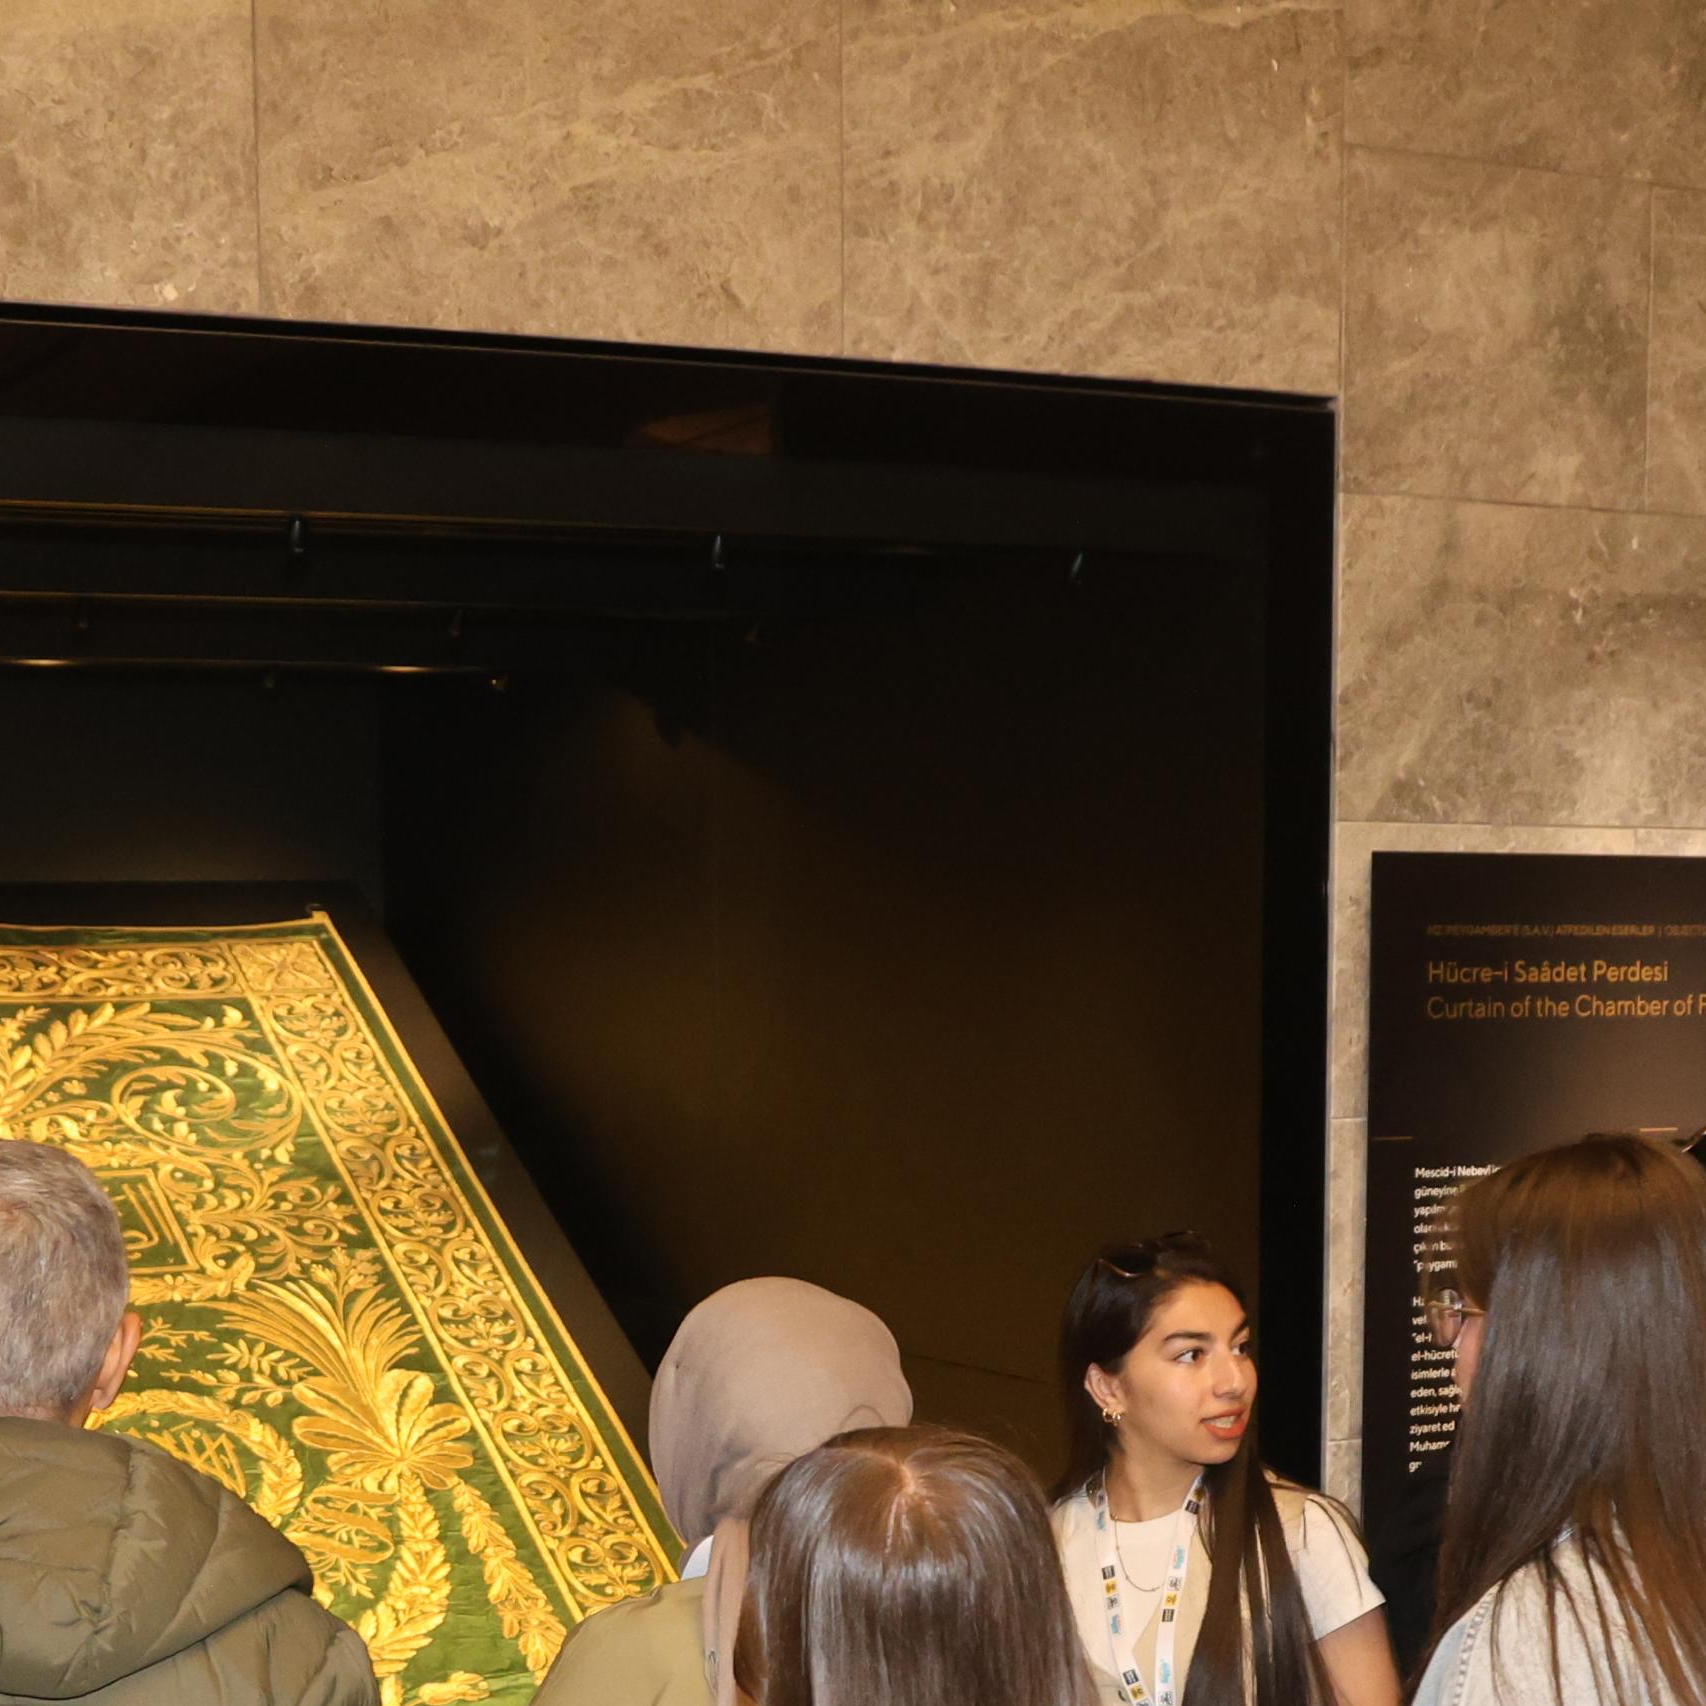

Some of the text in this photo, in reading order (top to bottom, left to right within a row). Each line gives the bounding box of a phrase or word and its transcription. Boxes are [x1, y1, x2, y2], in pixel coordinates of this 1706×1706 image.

[1594, 959, 1669, 982] Perdesi
[1428, 996, 1505, 1019] Curtain
[1510, 995, 1531, 1018] of
[1536, 995, 1569, 1017] the
[1575, 994, 1669, 1016] Chamber
[1673, 994, 1694, 1016] of
[1410, 1367, 1449, 1380] isimlerle
[1410, 1387, 1437, 1399] eden,
[1410, 1404, 1448, 1417] etkisiyle
[1409, 1423, 1441, 1436] ziyaret
